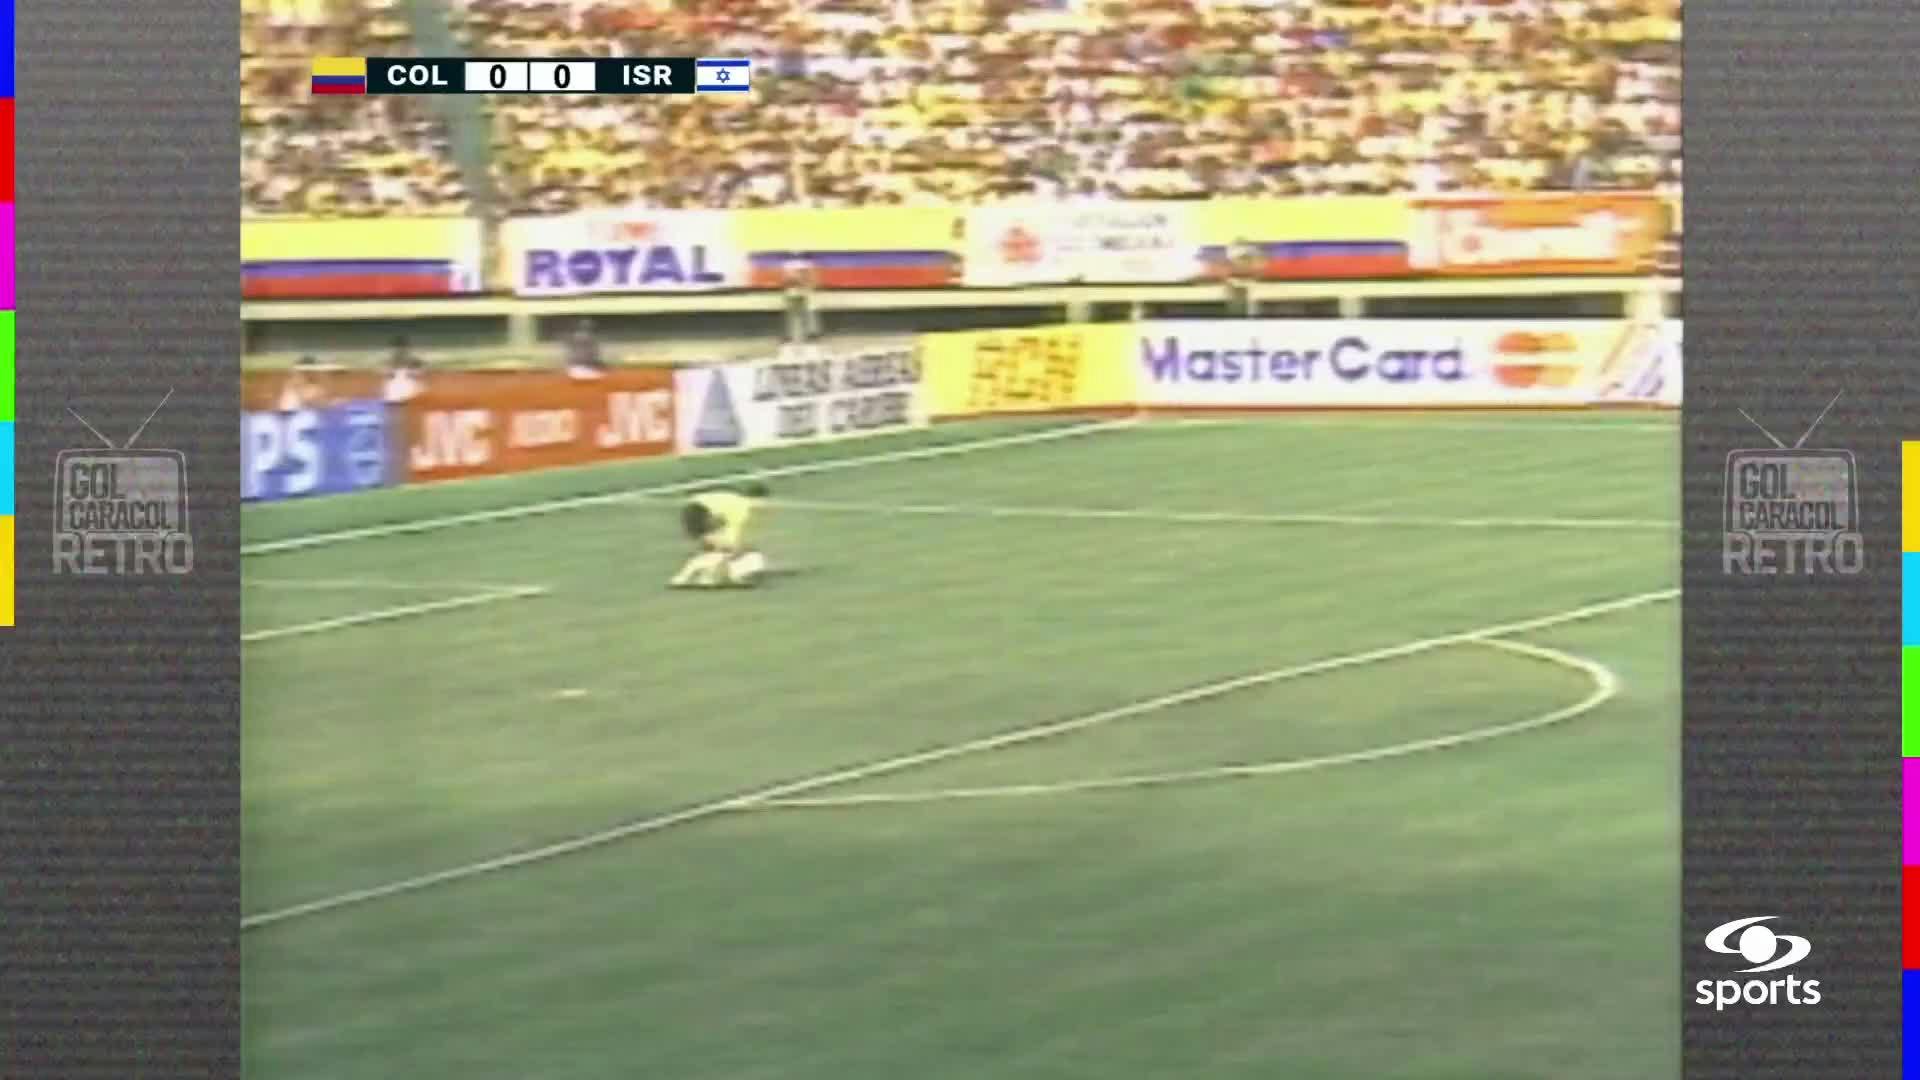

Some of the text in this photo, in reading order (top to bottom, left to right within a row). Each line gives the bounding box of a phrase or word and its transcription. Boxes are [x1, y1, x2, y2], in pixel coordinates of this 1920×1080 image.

[524, 246, 724, 288] ROYAL
[410, 409, 493, 471] JVC
[594, 388, 671, 448] JVC
